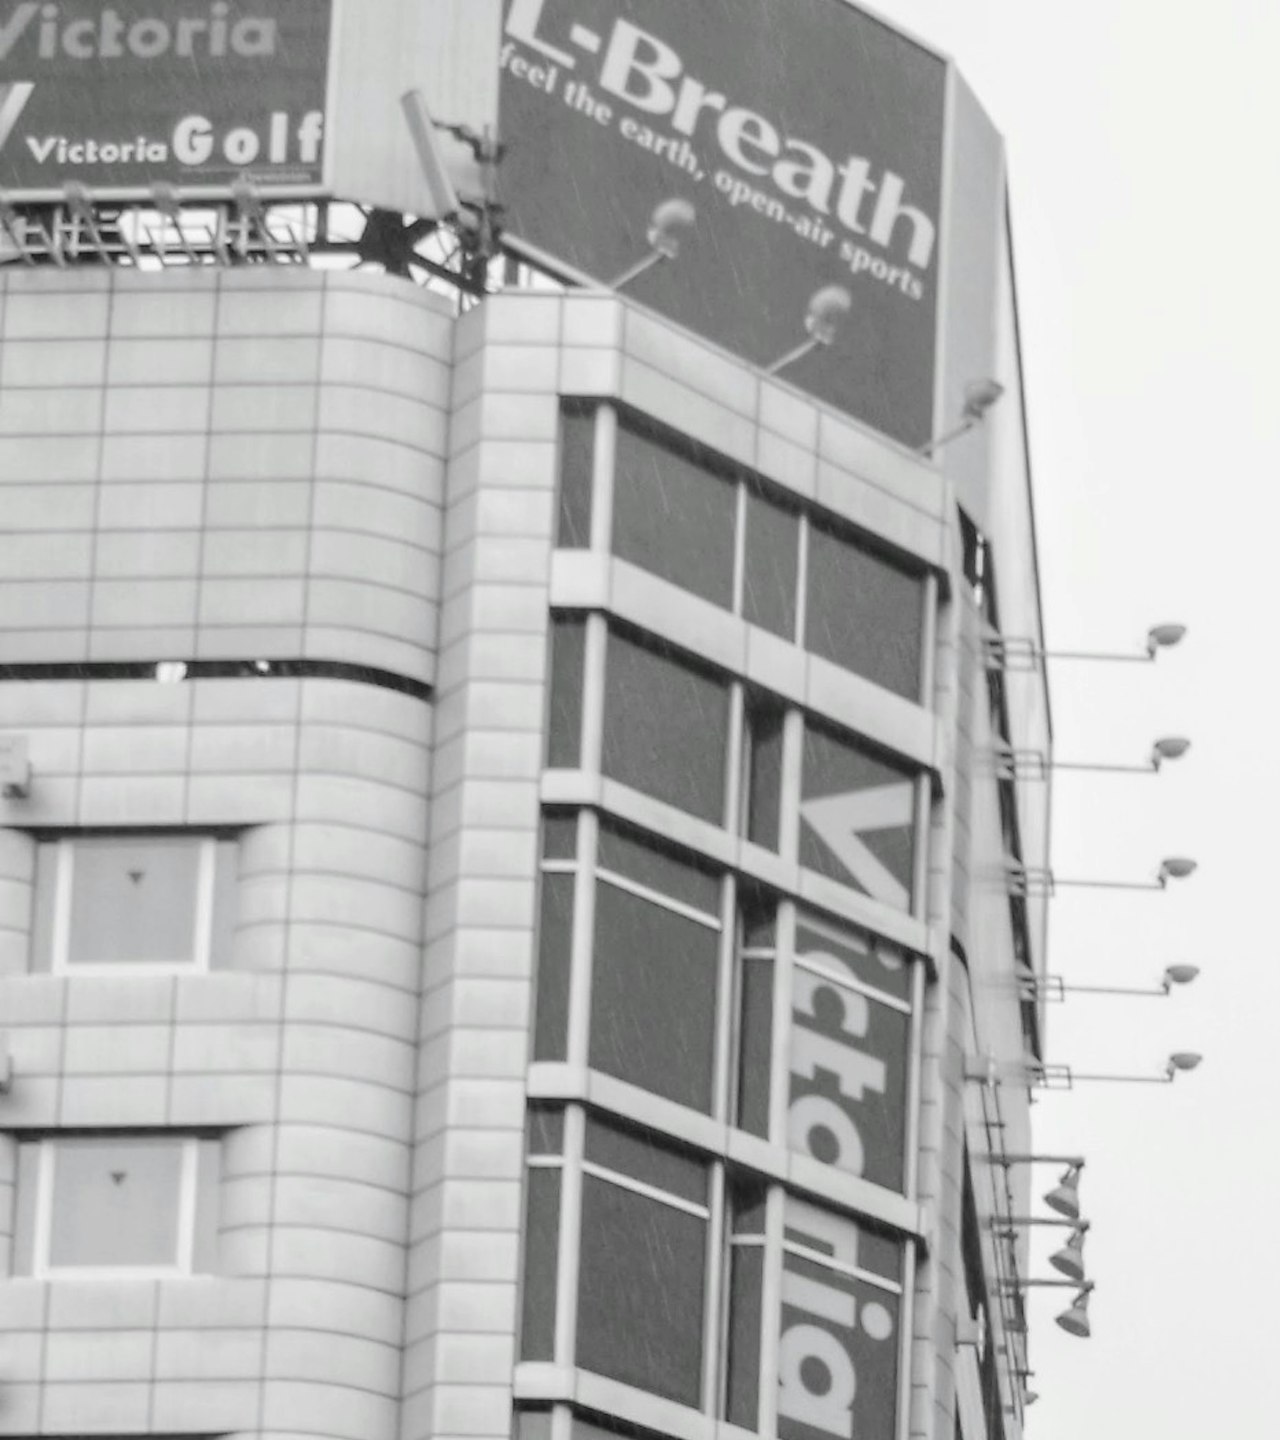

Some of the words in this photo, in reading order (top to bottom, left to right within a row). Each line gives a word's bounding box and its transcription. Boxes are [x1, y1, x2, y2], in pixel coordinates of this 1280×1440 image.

[26, 136, 167, 163] Victoria
[172, 110, 323, 165] Golf
[499, 42, 557, 94] feel
[564, 80, 612, 126] the
[619, 114, 703, 181] earth,
[714, 168, 834, 248] open-air
[839, 237, 924, 300] sports
[504, 0, 936, 270] L-Breath
